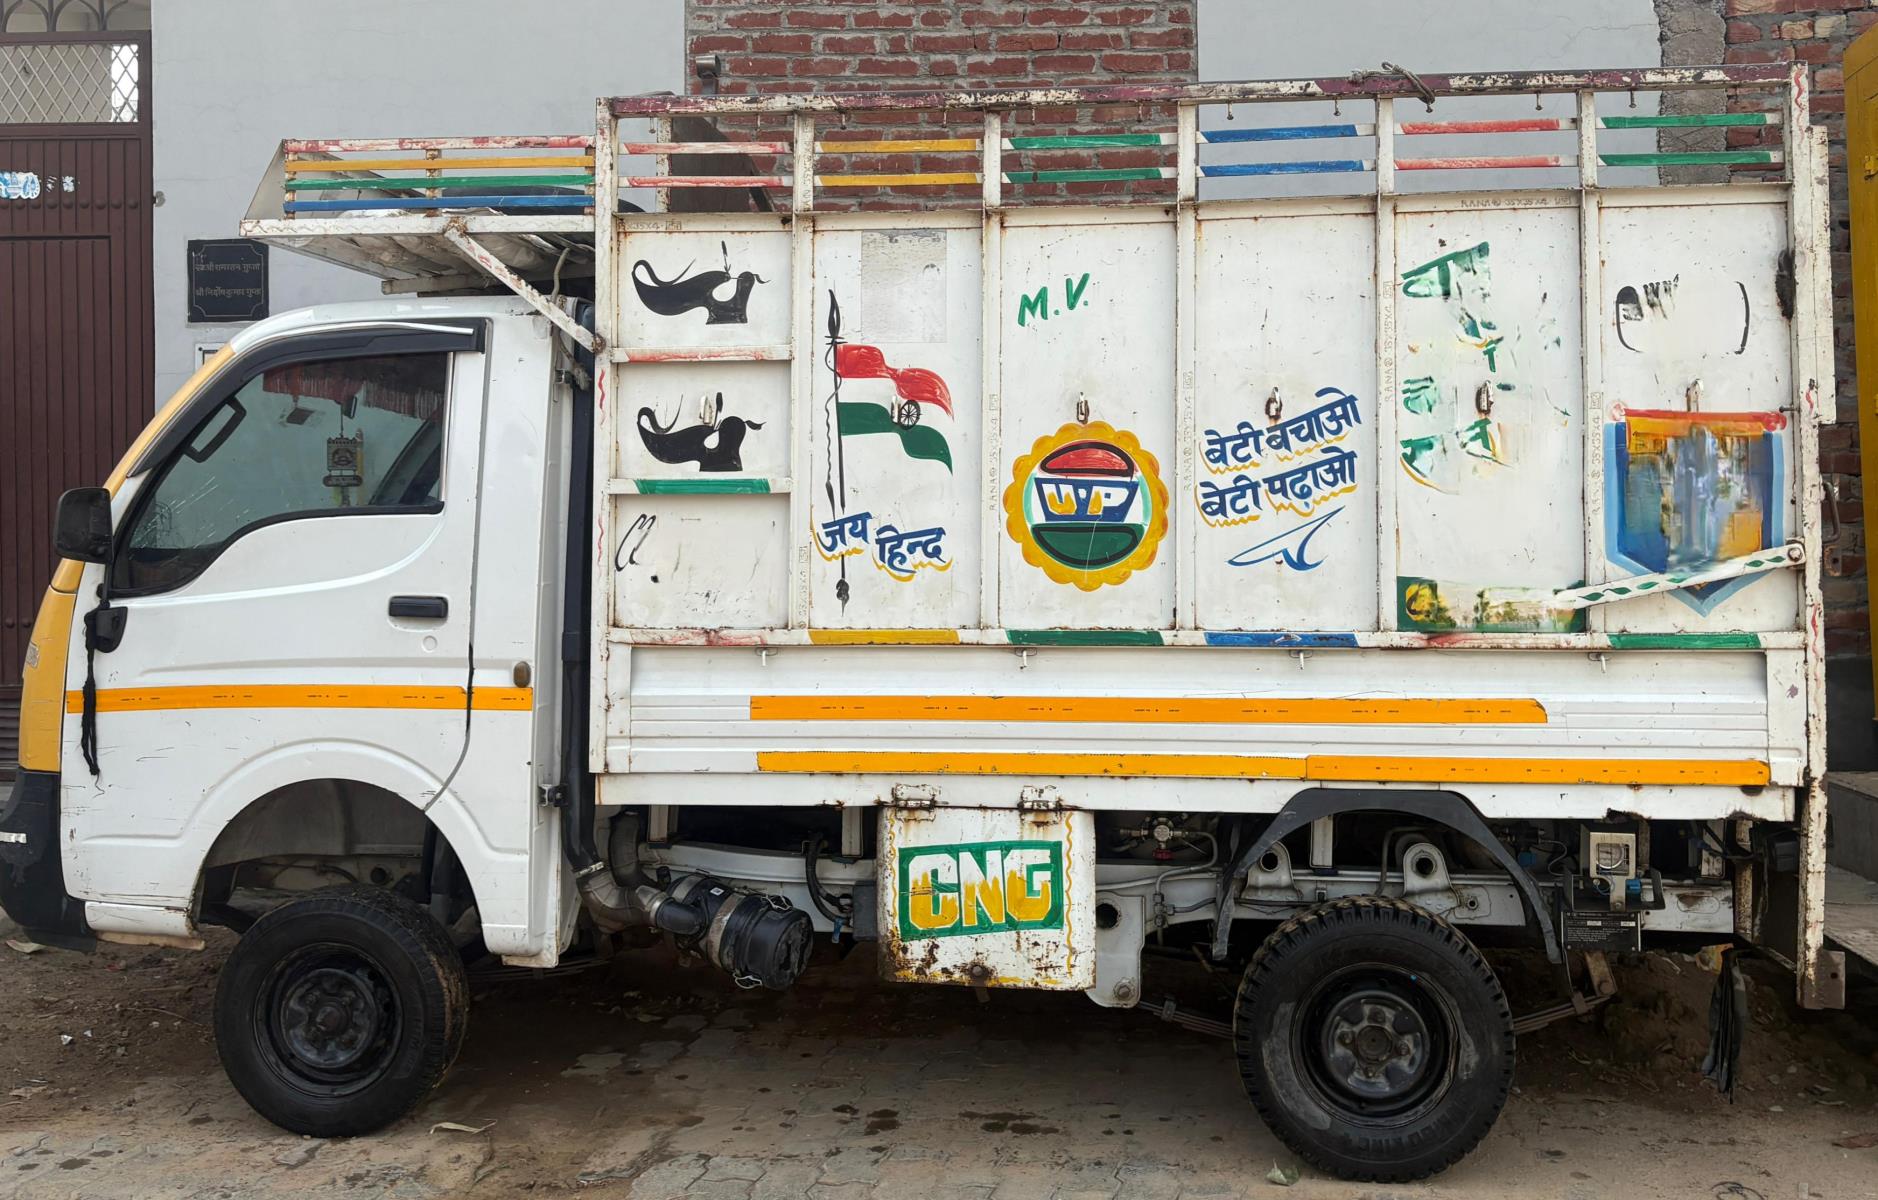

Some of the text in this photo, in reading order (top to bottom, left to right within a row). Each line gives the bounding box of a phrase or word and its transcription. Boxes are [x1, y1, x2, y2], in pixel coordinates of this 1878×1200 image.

[1205, 387, 1361, 466] बेटी बचाओ
[1200, 446, 1357, 518] बेटी पढ़ाओ
[817, 512, 946, 573] जय हिन्द
[909, 848, 1052, 930] CNG
